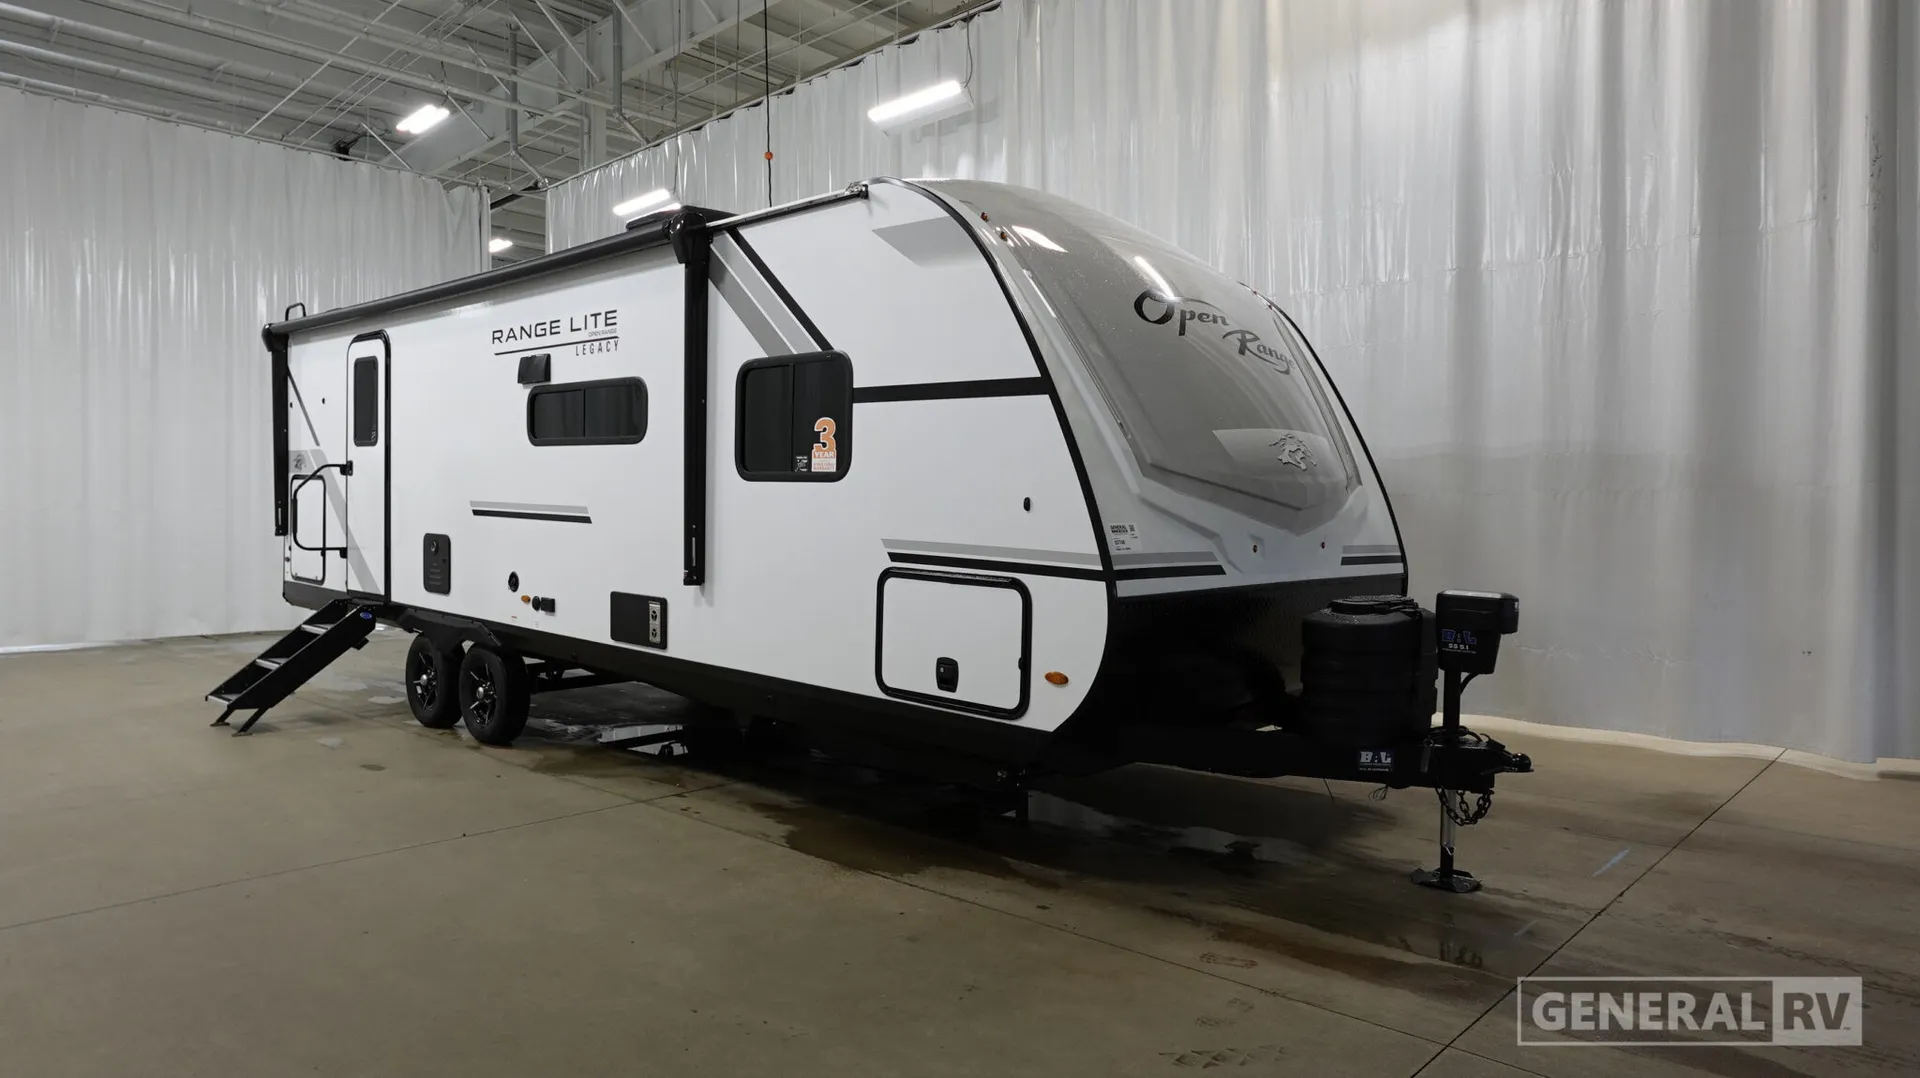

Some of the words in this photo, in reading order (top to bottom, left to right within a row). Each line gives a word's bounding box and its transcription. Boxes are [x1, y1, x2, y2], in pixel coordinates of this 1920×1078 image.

[492, 319, 561, 344] RANGE
[570, 309, 618, 332] LITE
[1134, 290, 1230, 336] Open
[1222, 329, 1295, 375] Range
[575, 340, 618, 356] LEGACY
[814, 417, 836, 451] 3
